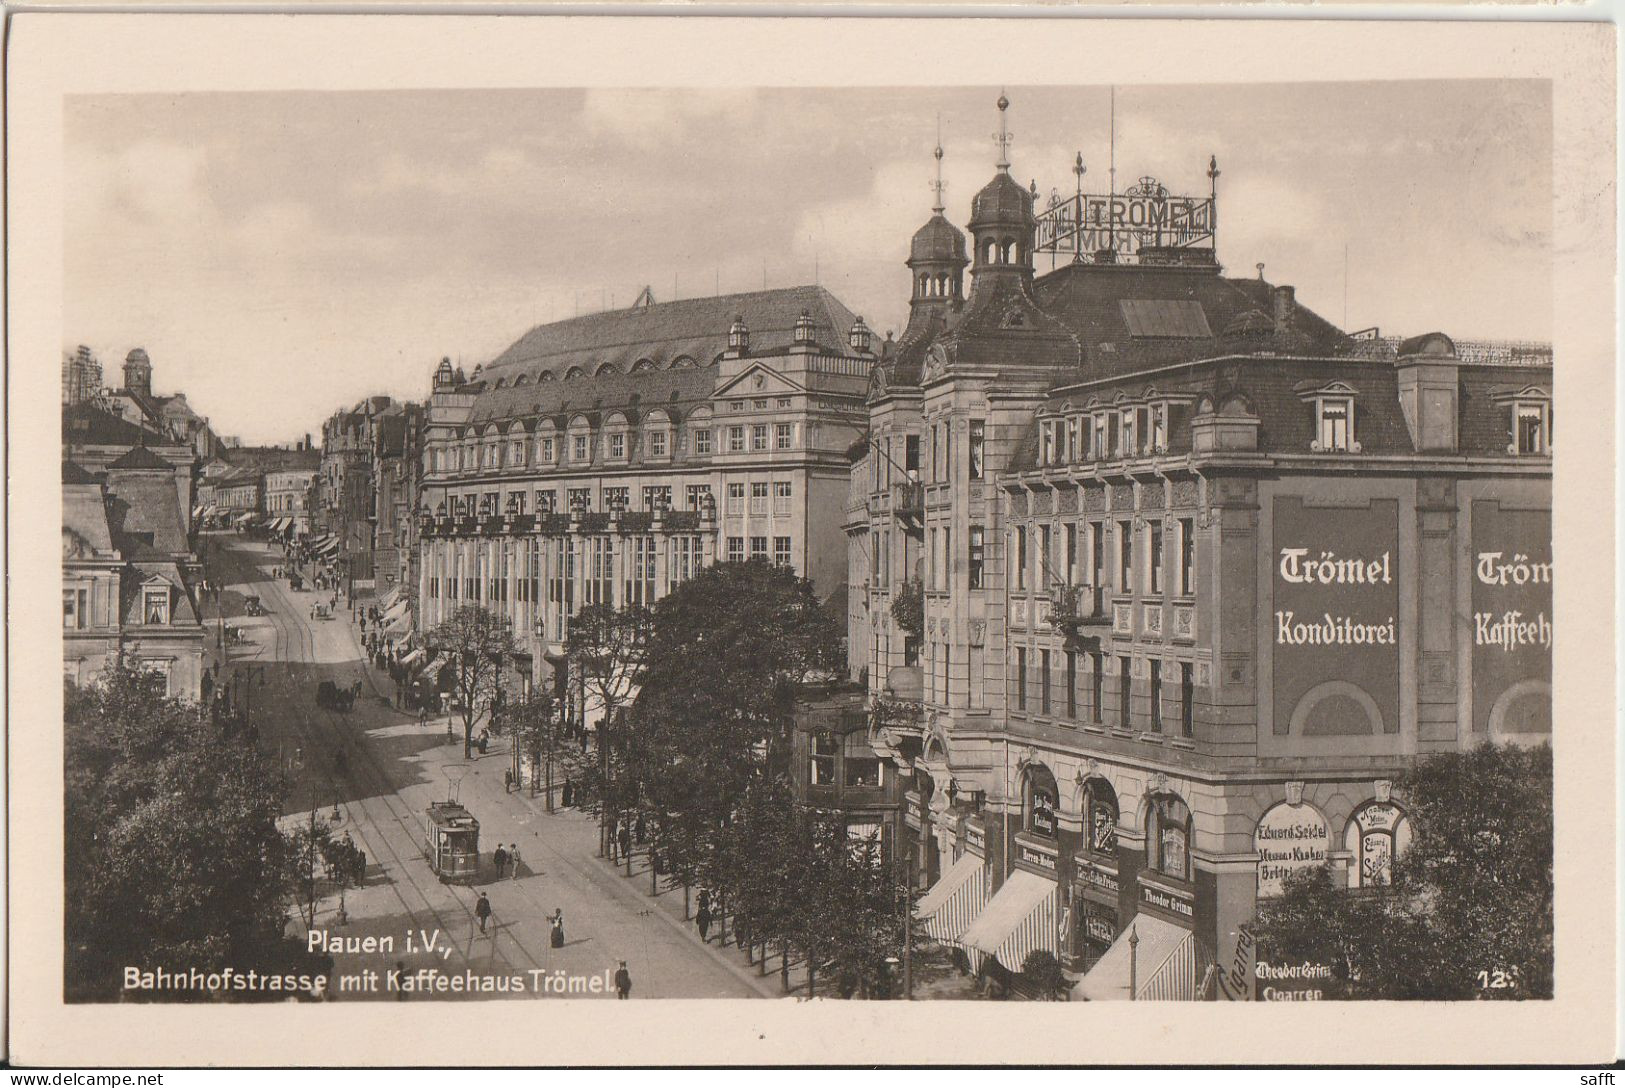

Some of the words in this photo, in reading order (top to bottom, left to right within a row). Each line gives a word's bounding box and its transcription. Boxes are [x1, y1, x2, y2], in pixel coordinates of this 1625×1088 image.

[1279, 547, 1392, 585] Trömel
[1275, 611, 1396, 645] Konditorei
[1145, 889, 1170, 908] Theodor
[1171, 898, 1193, 916] Grimm
